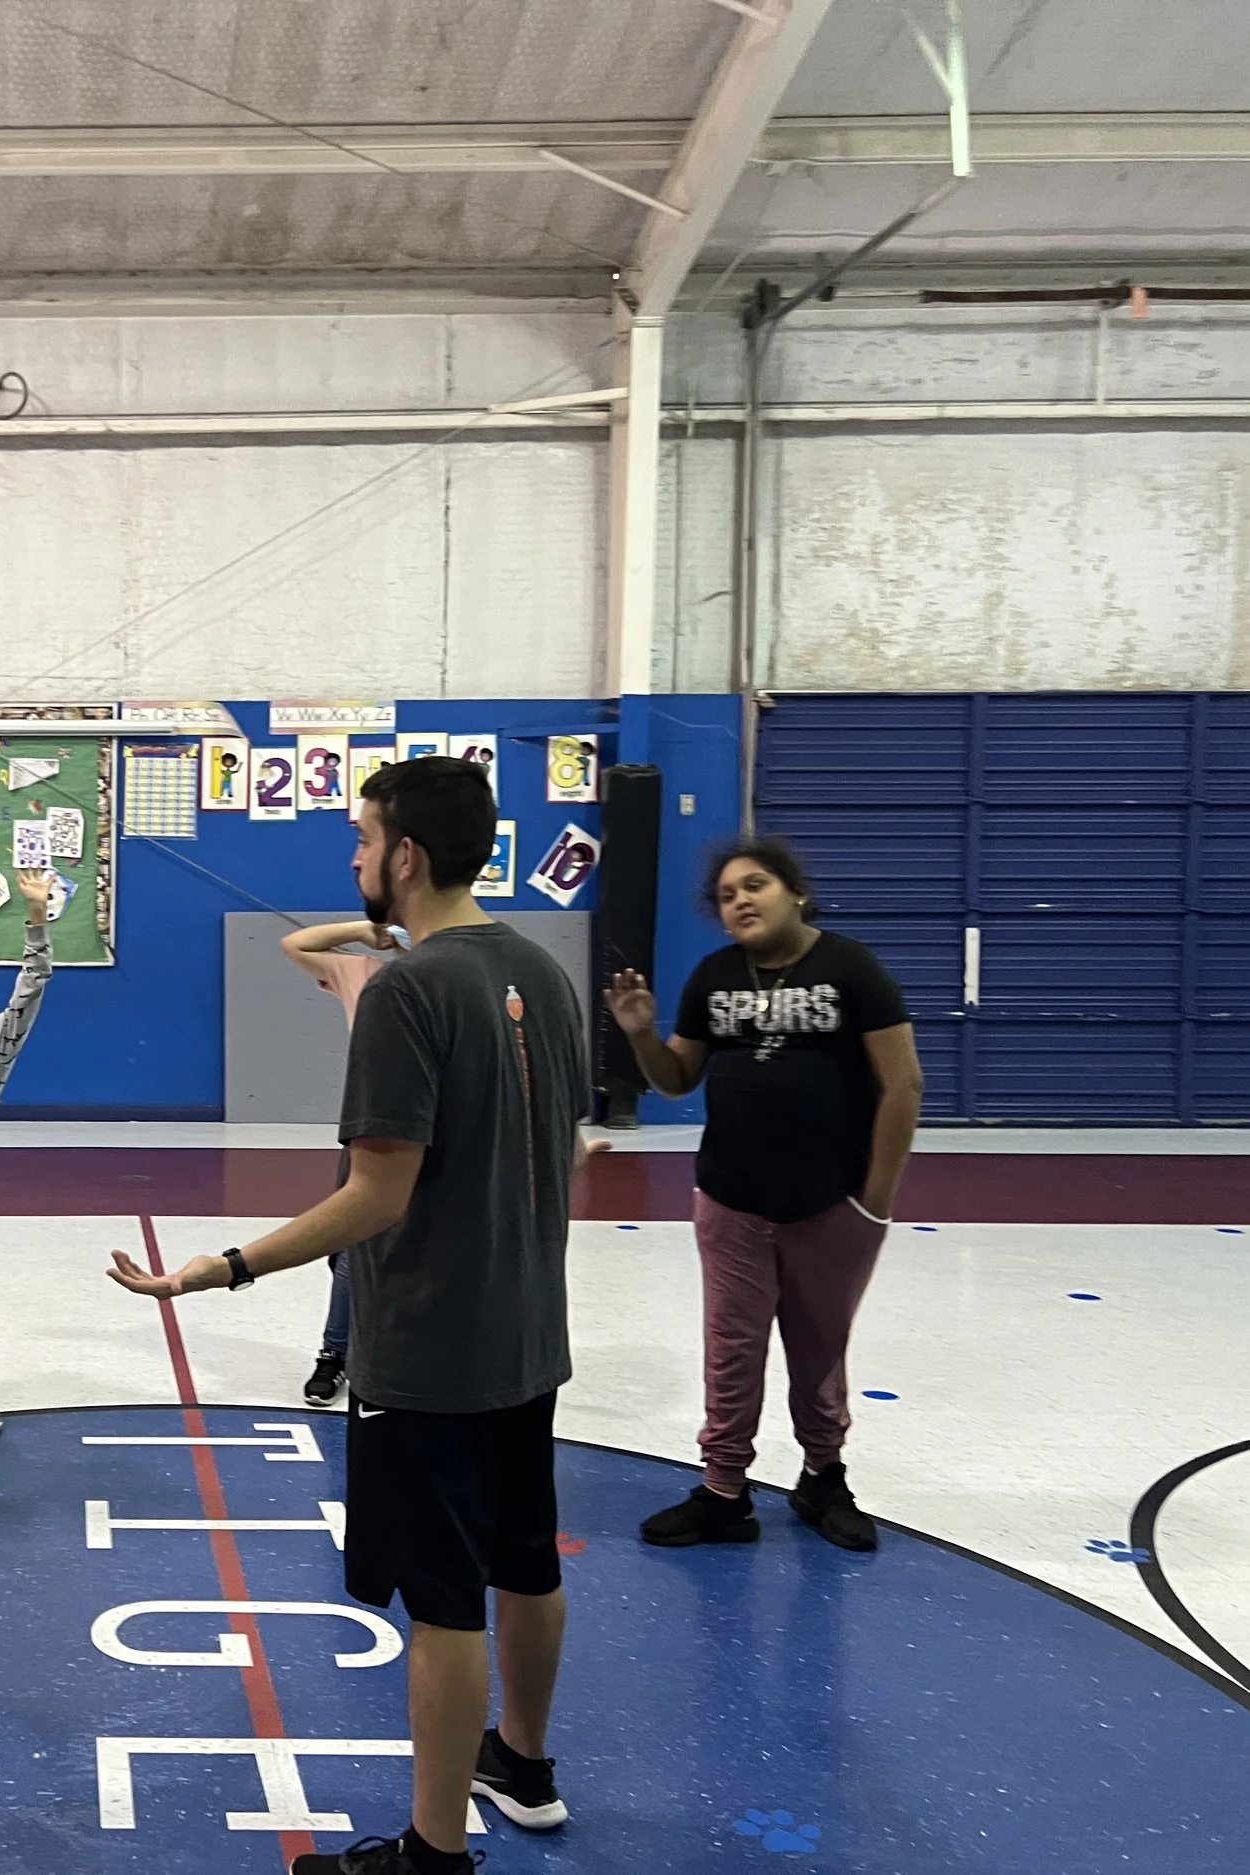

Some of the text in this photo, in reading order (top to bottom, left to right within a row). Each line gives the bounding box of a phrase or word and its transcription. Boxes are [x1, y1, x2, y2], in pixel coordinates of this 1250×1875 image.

[258, 758, 292, 807] 2
[305, 748, 332, 797] 3
[551, 736, 583, 788] 8
[538, 831, 596, 890] 10
[707, 984, 841, 1037] SPURS
